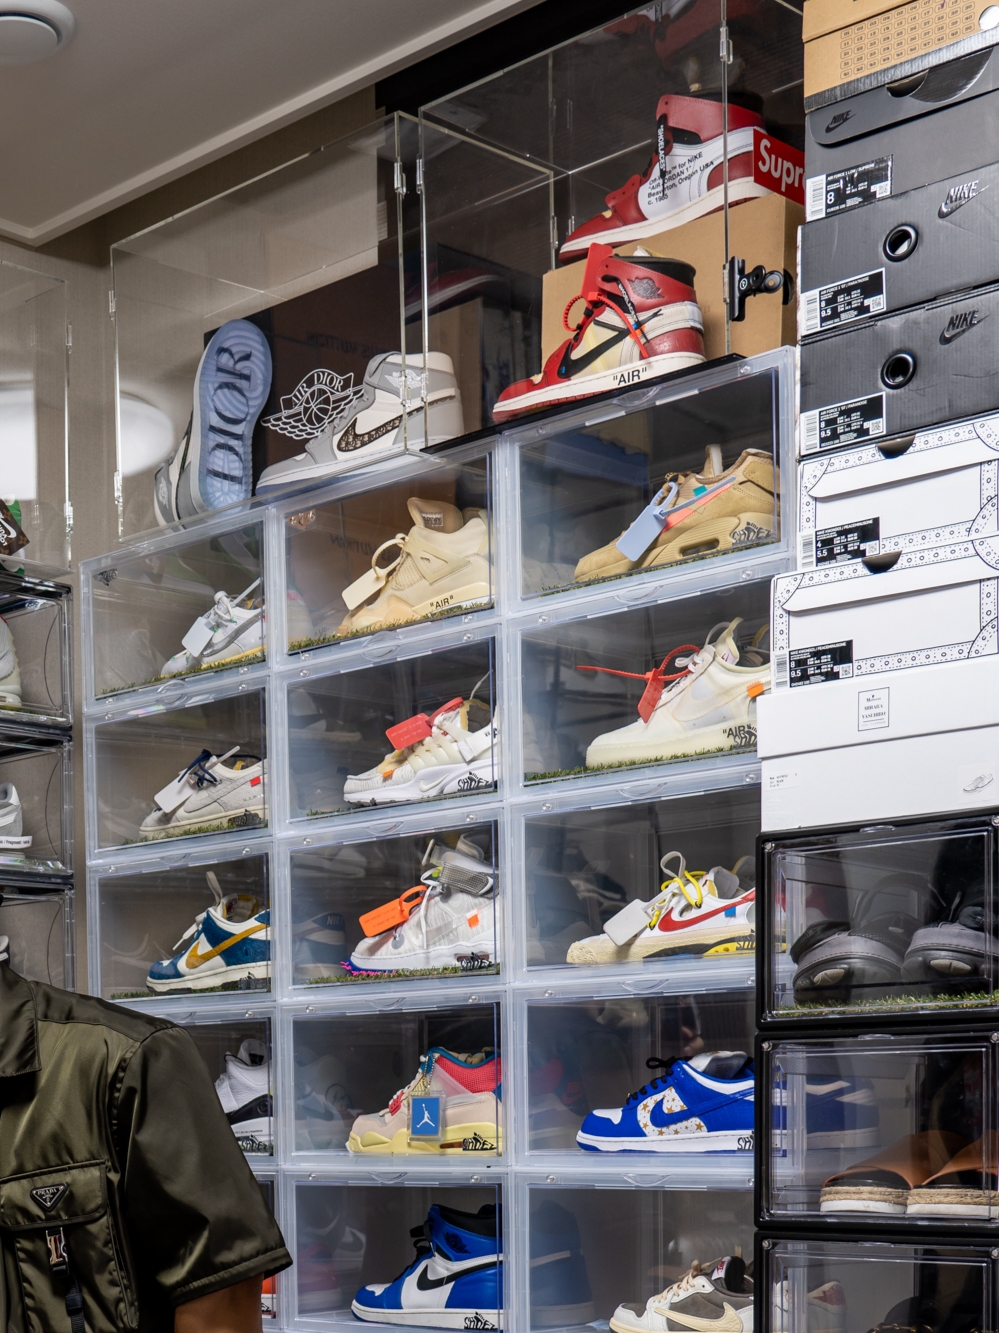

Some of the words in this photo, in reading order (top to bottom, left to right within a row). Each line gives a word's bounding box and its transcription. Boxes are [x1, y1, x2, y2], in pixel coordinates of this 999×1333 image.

[830, 109, 852, 126] NIKE
[687, 151, 703, 165] NIKE
[758, 138, 805, 193] Supr
[647, 182, 677, 199] Beavrton,
[677, 169, 698, 185] Oregon
[699, 160, 714, 173] USA
[662, 169, 685, 187] ORDAN
[827, 192, 835, 204] 8
[945, 179, 979, 205] NIKE
[820, 300, 826, 308] 8
[820, 308, 832, 318] 9.5
[945, 309, 979, 333] NIKE
[613, 366, 647, 386] "AIR"
[292, 382, 310, 408] AIR
[313, 371, 344, 393] DIOR
[206, 345, 252, 488] DIOR
[820, 429, 832, 438] 9.5
[816, 540, 822, 548] 4
[816, 549, 828, 558] 5.5
[429, 594, 454, 611] "AIR"
[790, 660, 796, 668] 8
[790, 670, 802, 678] 9.5
[38, 1188, 57, 1196] PRADA
